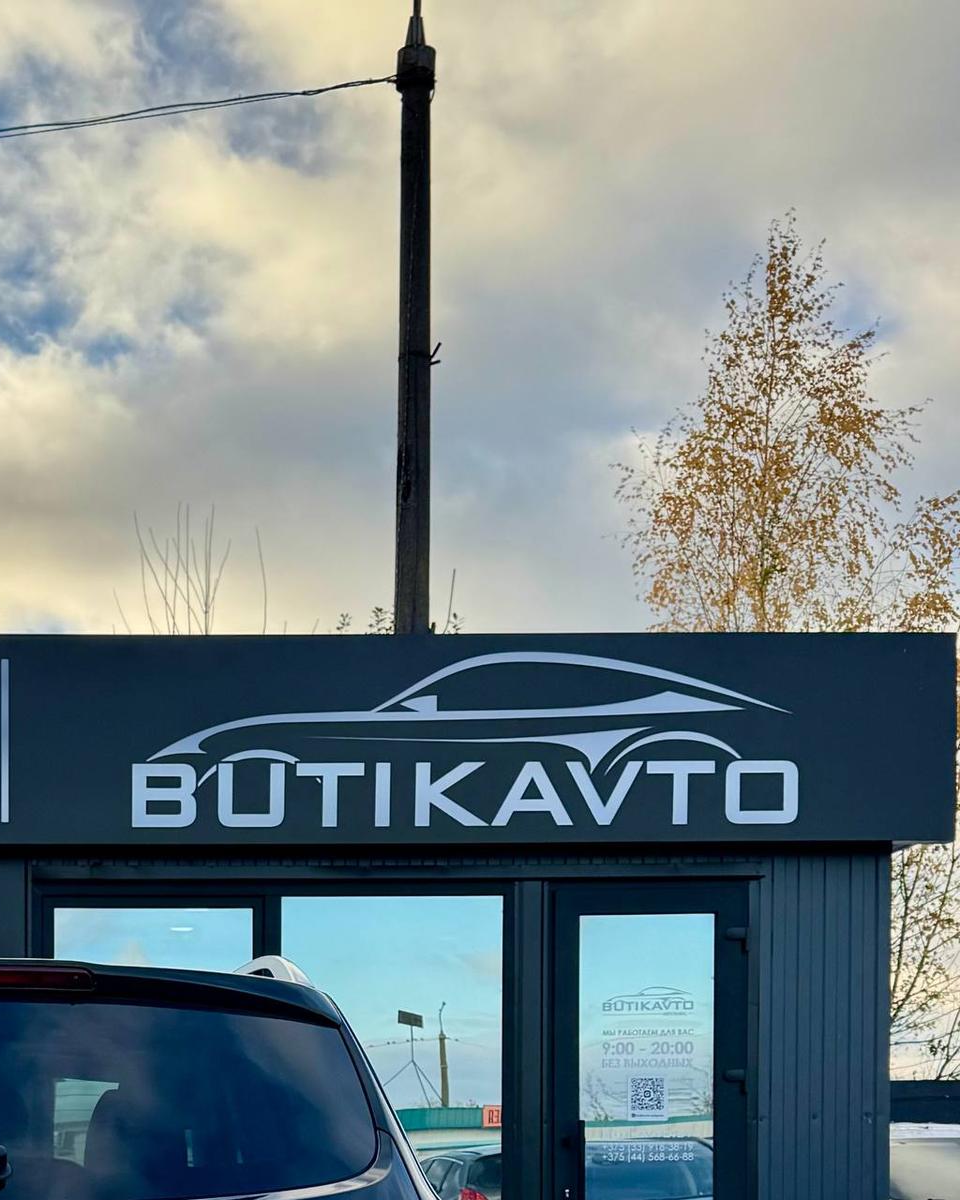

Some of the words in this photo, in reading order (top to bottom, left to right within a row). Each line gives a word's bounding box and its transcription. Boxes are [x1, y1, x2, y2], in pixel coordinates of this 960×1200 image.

[131, 759, 799, 828] BUTIKAVTO
[602, 1001, 694, 1012] BUTIKAVTO
[602, 1041, 634, 1055] 9:00
[650, 1041, 694, 1055] 20:00
[602, 1059, 621, 1068] БЕЗ
[624, 1058, 693, 1068] ВЫХОДНЫХ
[602, 1153, 625, 1161] +375
[628, 1152, 645, 1163] (44)
[648, 1152, 694, 1161] 568-66-88
